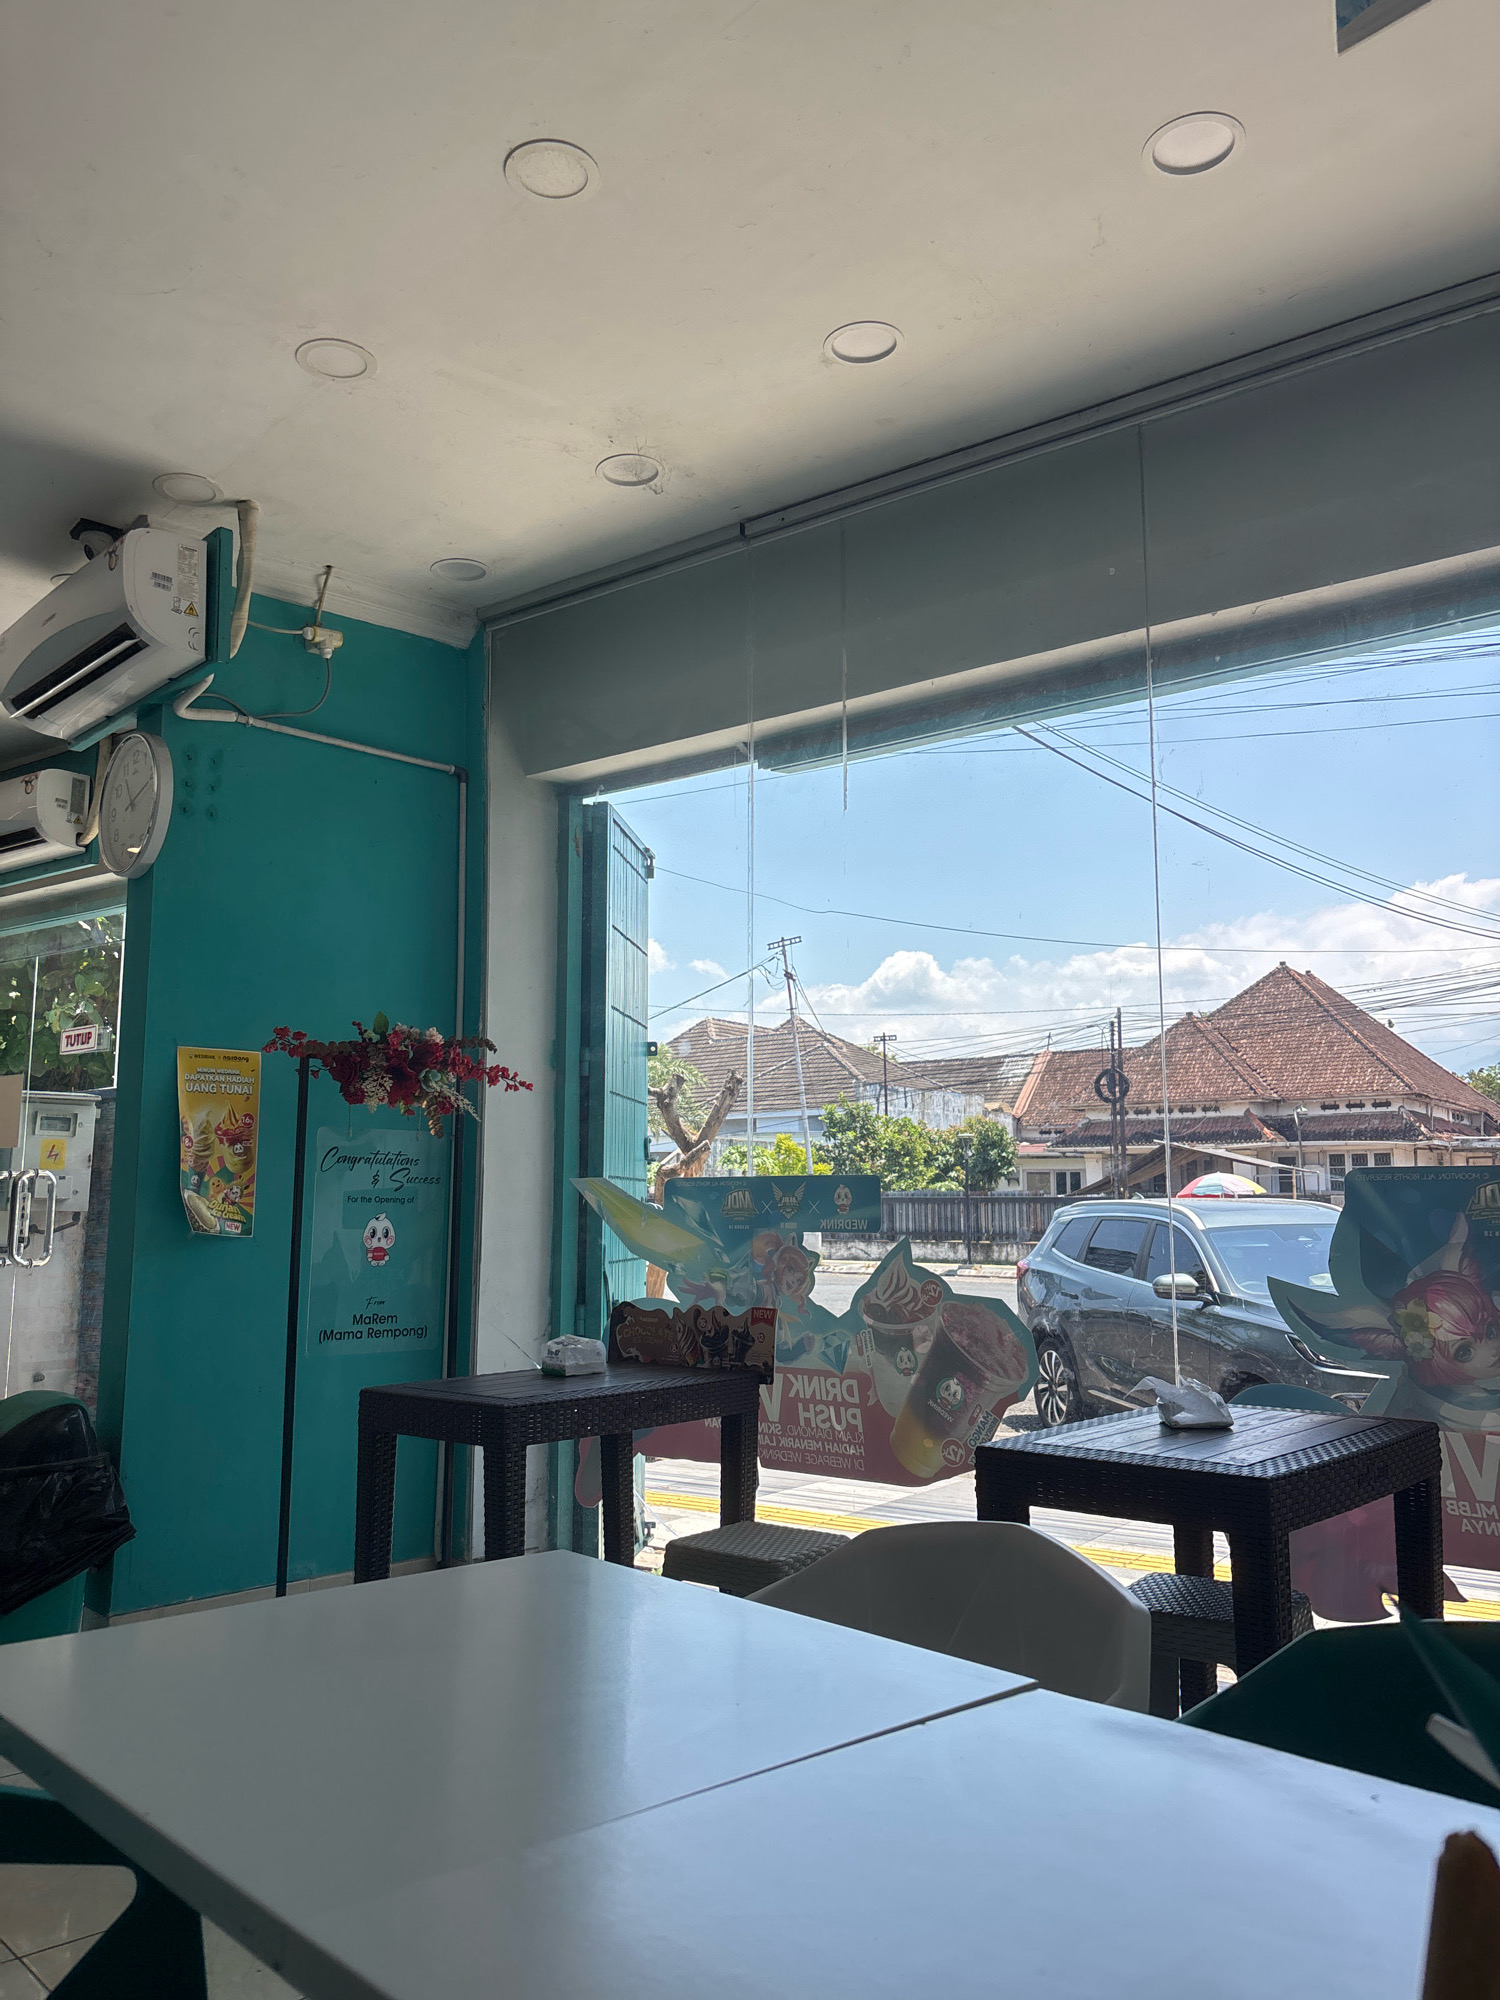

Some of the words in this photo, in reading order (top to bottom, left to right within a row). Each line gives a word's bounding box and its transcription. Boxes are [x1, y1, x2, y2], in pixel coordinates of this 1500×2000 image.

[65, 1031, 93, 1048] TUTUP
[196, 1067, 216, 1075] MINUM
[216, 1068, 241, 1076] WEDRINK
[184, 1073, 225, 1083] DAPATKAN
[226, 1075, 255, 1085] HADIAH
[185, 1082, 217, 1094] UANG
[219, 1083, 253, 1095] TUNAI
[320, 1146, 420, 1173] Congratulations
[389, 1167, 442, 1192] Success
[347, 1195, 359, 1203] For
[374, 1196, 406, 1205] Opening
[407, 1196, 415, 1204] of
[208, 1199, 242, 1215] Durian
[226, 1222, 241, 1232] NEW
[352, 1313, 398, 1326] MaRem
[753, 1309, 774, 1320] NEW
[318, 1329, 363, 1344] (Mama
[367, 1325, 428, 1340] Rempong)
